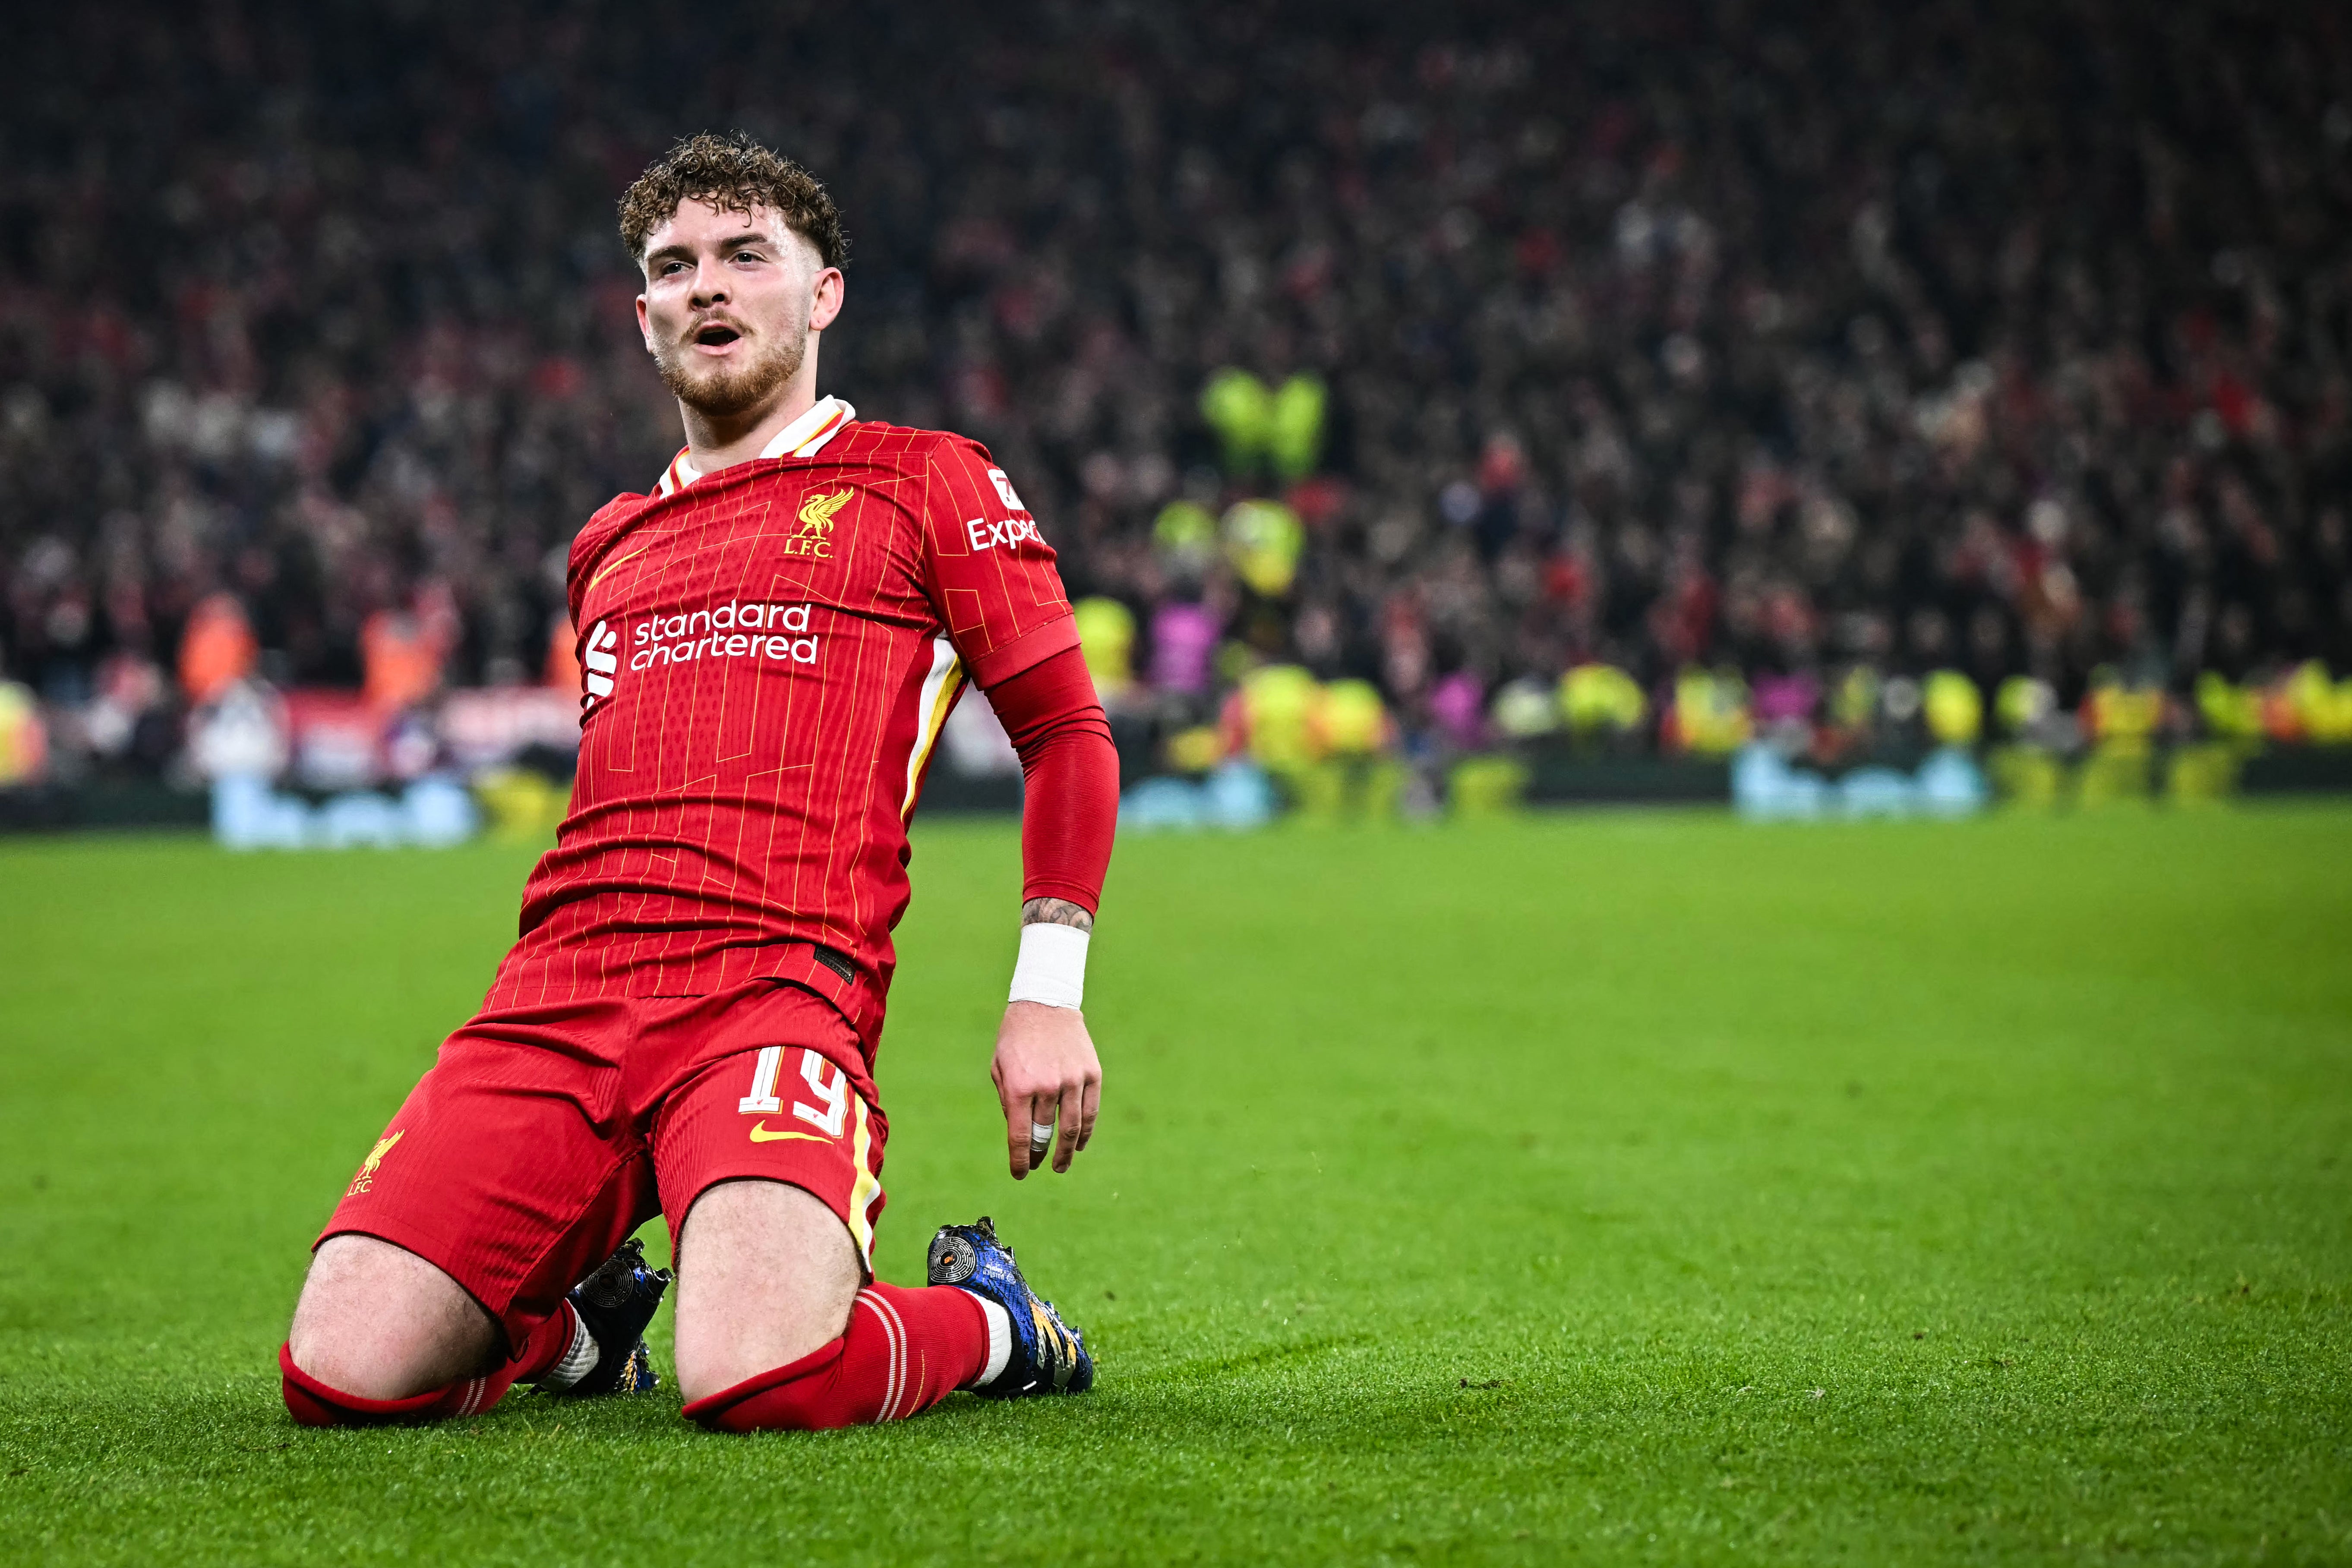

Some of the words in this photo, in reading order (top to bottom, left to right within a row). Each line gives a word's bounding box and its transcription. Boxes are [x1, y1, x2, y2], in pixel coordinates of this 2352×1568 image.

[783, 539, 833, 558] L.F.C.
[634, 598, 811, 645] standard
[630, 631, 818, 671] chartered
[738, 1046, 848, 1139] 19
